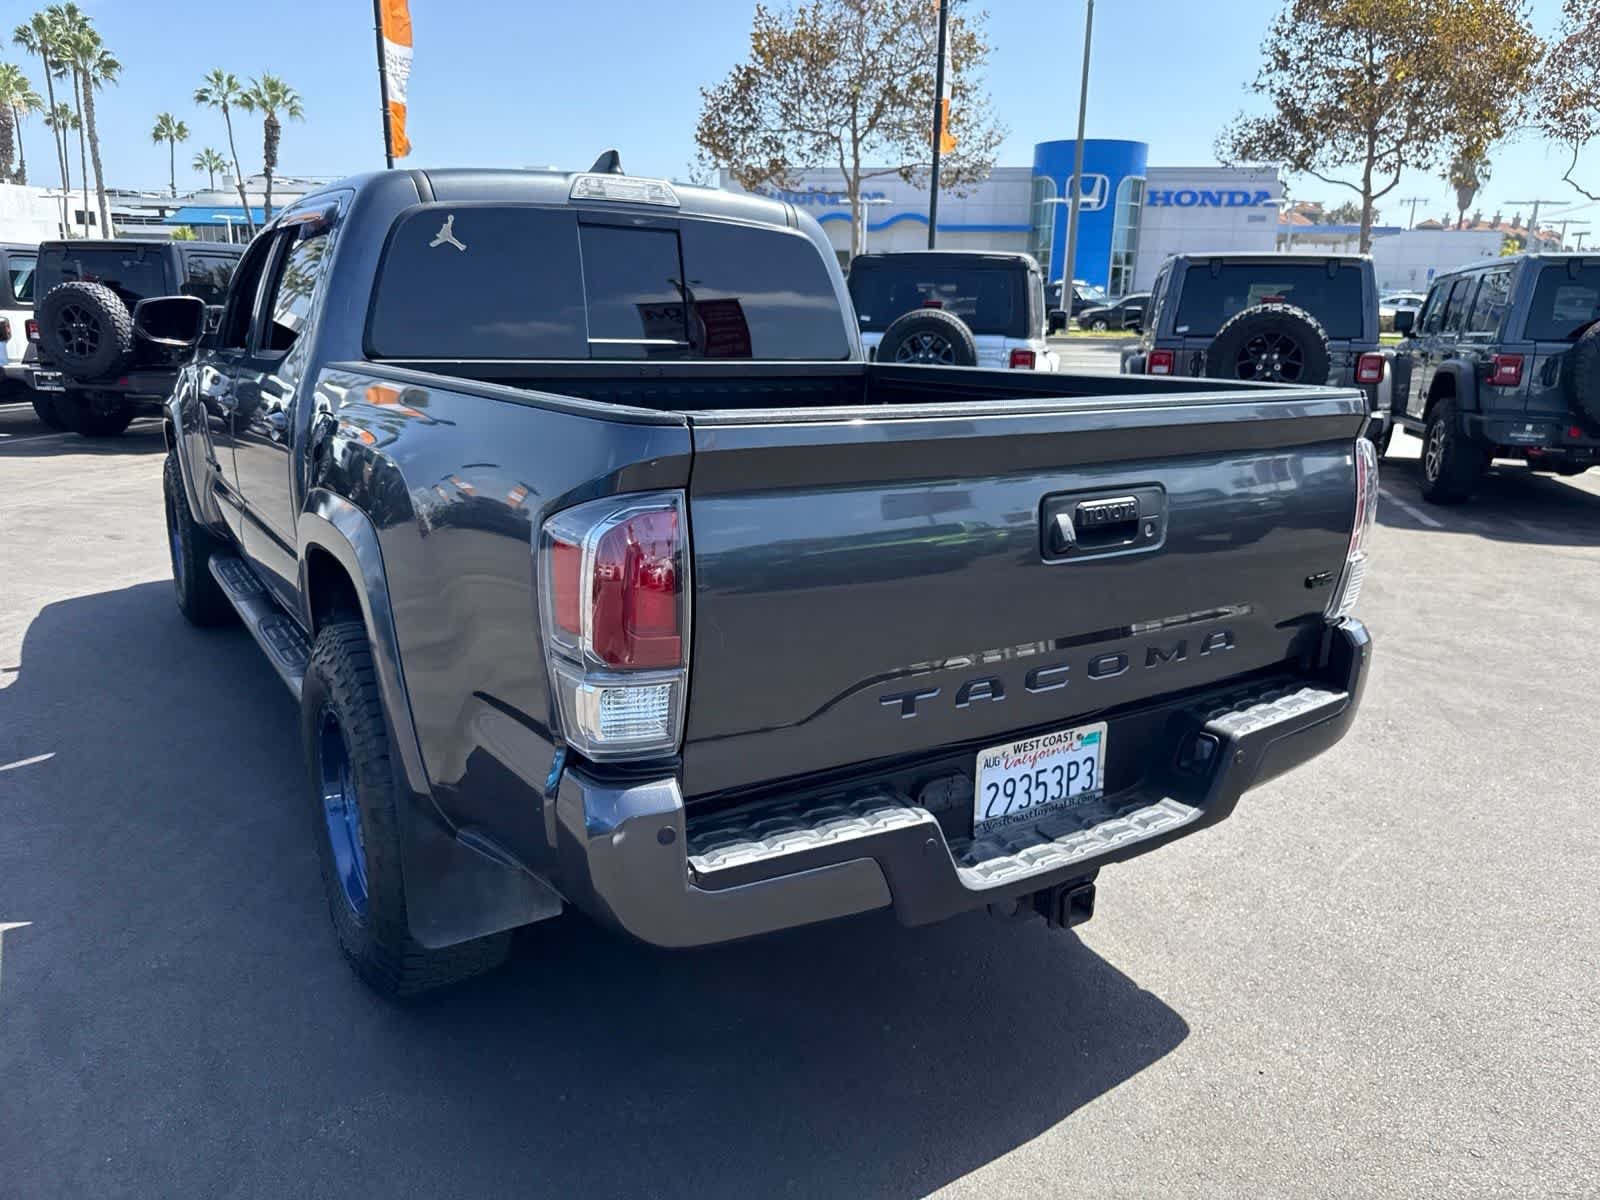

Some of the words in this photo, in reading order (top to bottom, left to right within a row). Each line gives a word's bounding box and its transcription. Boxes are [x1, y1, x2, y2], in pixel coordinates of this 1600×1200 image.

[1146, 189, 1278, 208] HONDA
[1084, 502, 1136, 521] TOYOTA
[879, 629, 1236, 720] TACOMA
[1013, 740, 1041, 755] WEST
[1042, 731, 1075, 748] COAST
[983, 755, 1001, 769] AUG
[1003, 742, 1082, 770] California
[984, 756, 1095, 819] 29353P3
